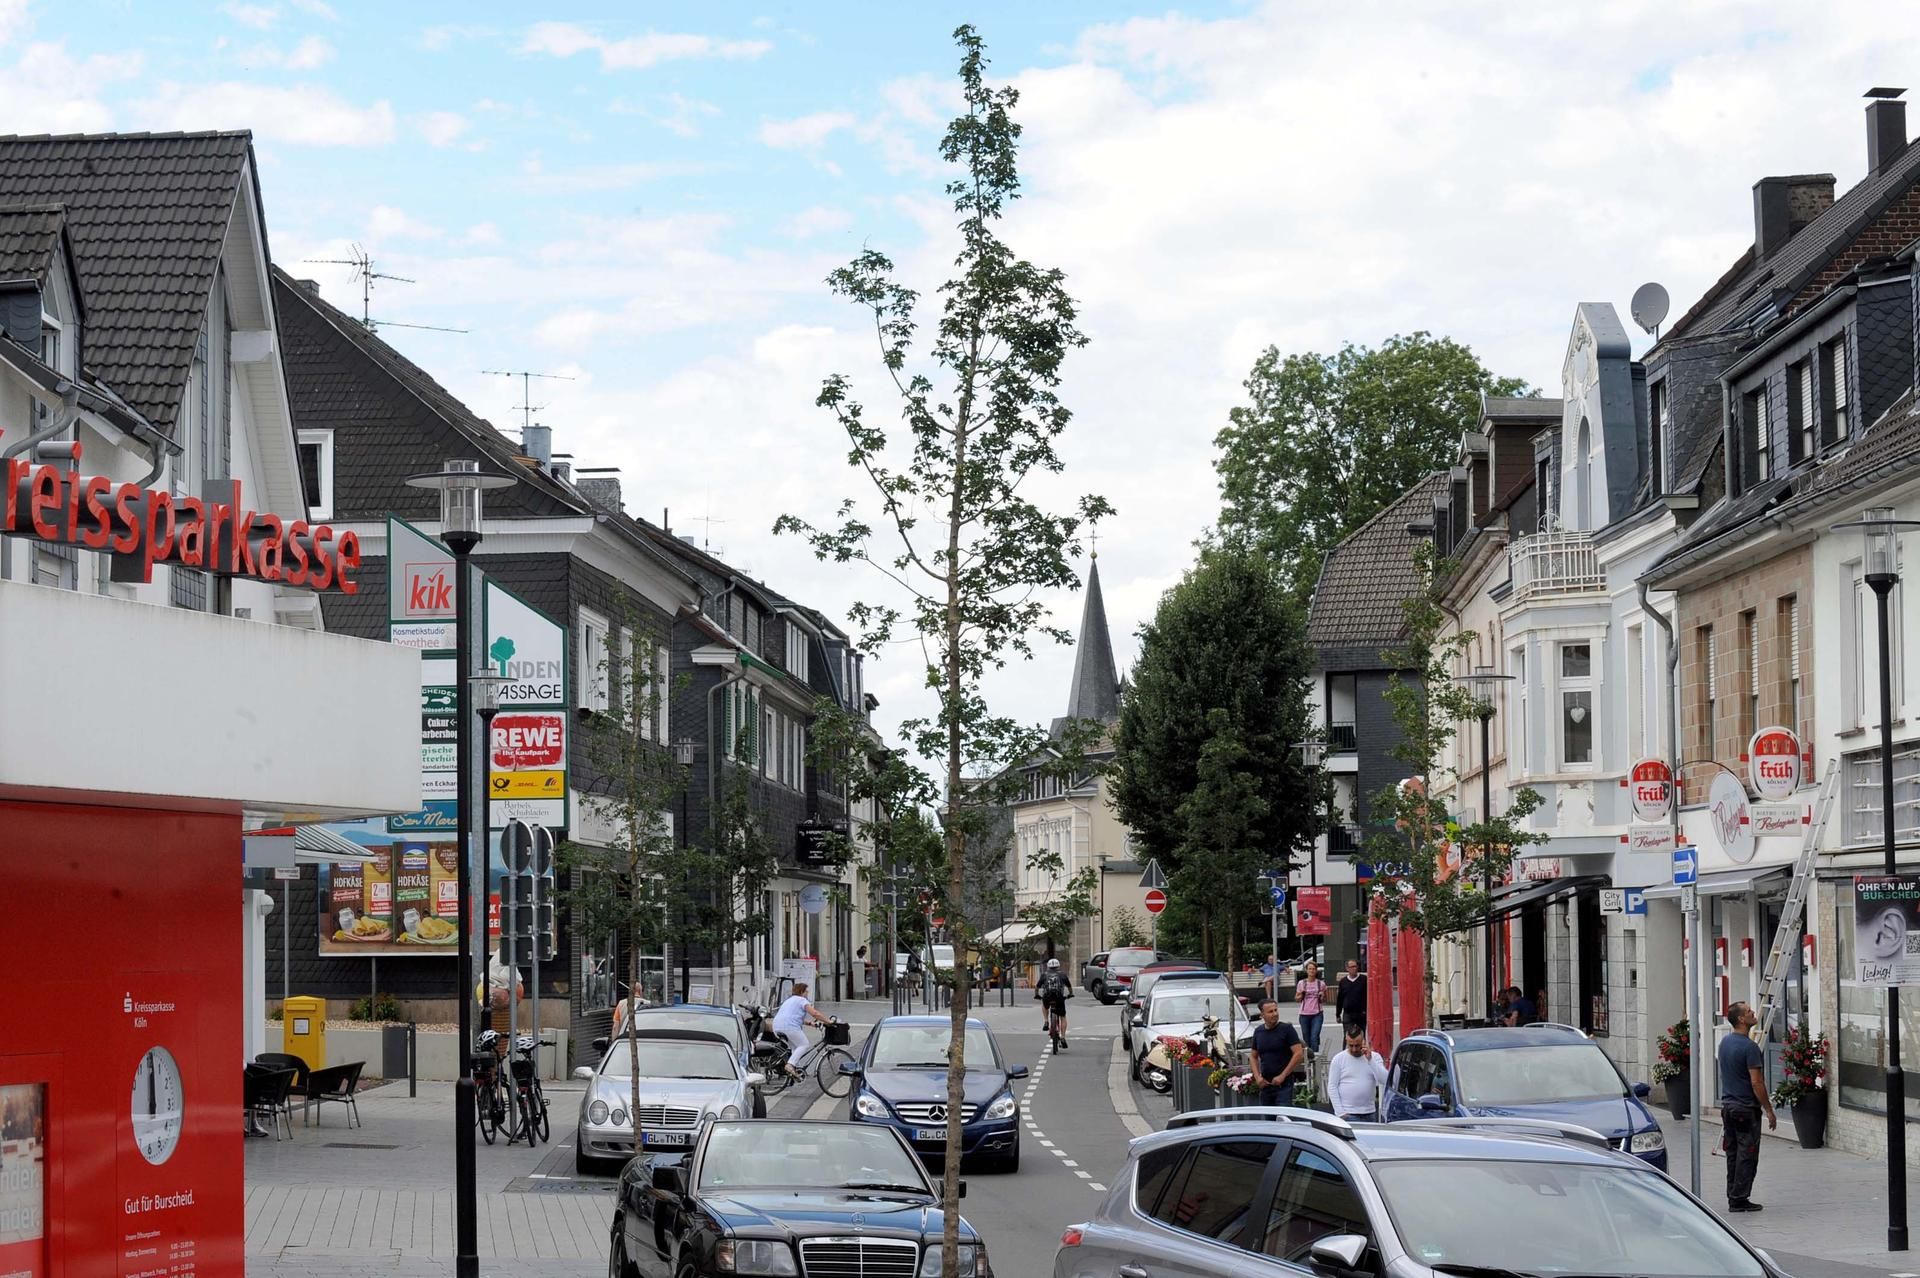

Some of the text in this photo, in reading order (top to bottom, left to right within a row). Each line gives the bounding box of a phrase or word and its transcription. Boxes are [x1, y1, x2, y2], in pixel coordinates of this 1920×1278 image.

[0, 428, 361, 596] reissparkasse
[393, 627, 445, 636] Kosmetikstudio
[421, 689, 457, 698] CHEIDER
[493, 727, 561, 747] REWE
[422, 746, 453, 756] gische
[1759, 760, 1793, 778] früh
[423, 812, 457, 826] Marc
[333, 876, 363, 888] HOFKÄSE
[397, 874, 429, 887] HOFKÄSE
[1857, 882, 1916, 892] OHREN AUF
[1604, 891, 1620, 901] City
[1604, 899, 1621, 907] Grill
[1627, 893, 1645, 911] P
[134, 1001, 175, 1015] Kreissparkasse
[134, 1017, 147, 1028] Köln
[647, 1133, 659, 1143] GL
[665, 1134, 677, 1144] TN
[919, 1130, 931, 1139] GL
[124, 1188, 195, 1214] Gut für Burscheid.
